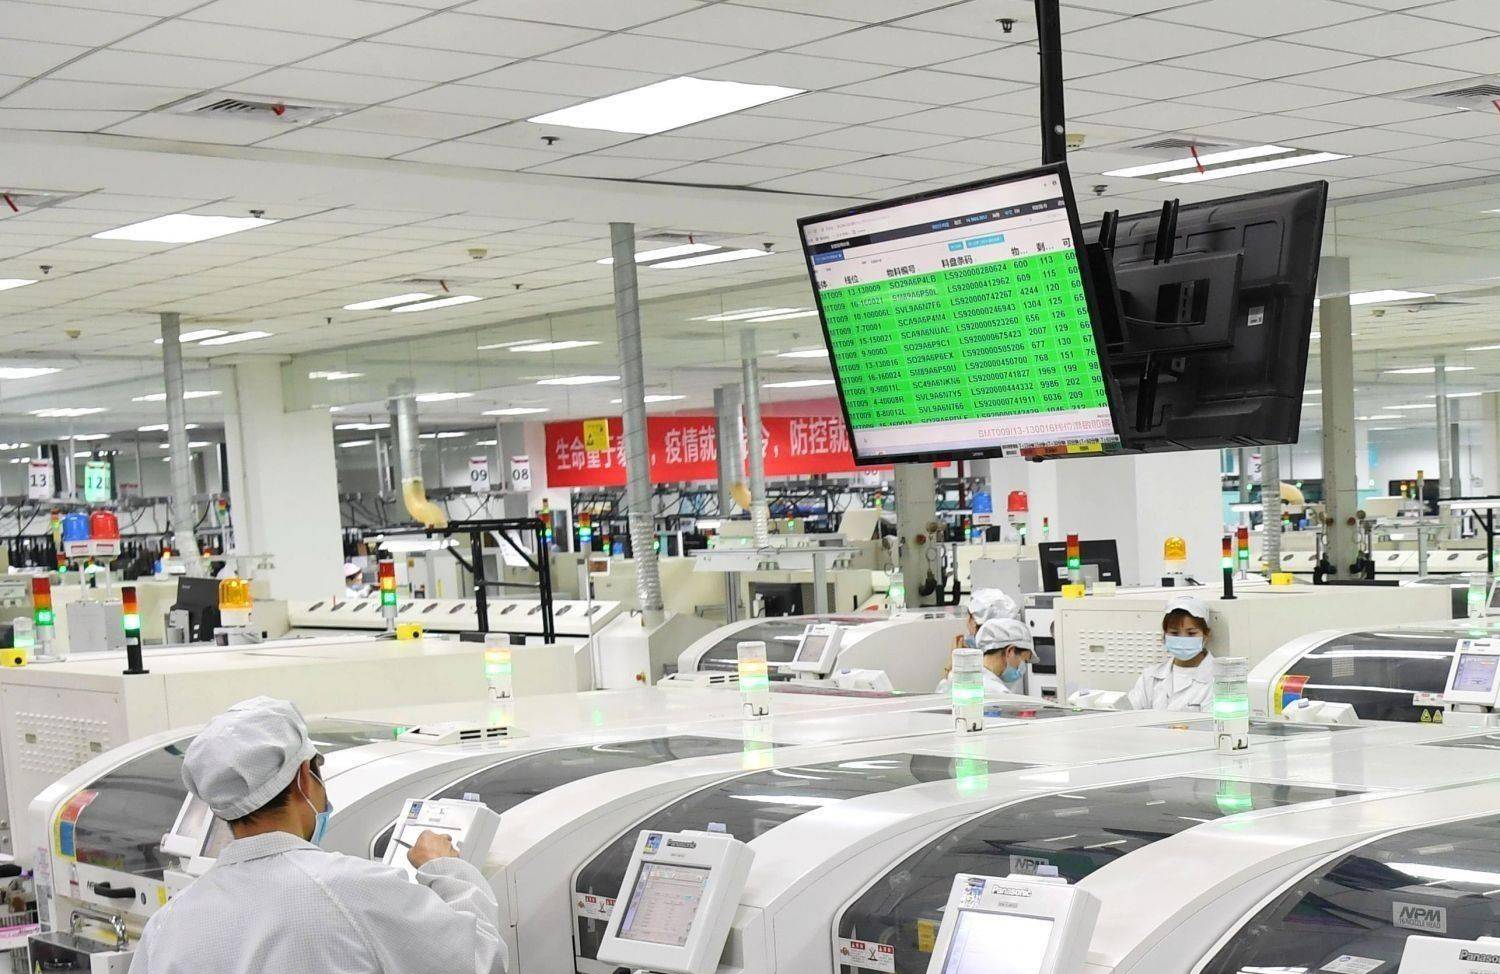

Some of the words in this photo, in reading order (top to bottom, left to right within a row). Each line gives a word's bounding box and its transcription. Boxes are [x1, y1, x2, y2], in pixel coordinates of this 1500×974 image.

[1039, 255, 1053, 264] 113
[1064, 251, 1076, 260] 60
[1042, 269, 1056, 278] 115
[1067, 265, 1079, 274] 60
[1045, 283, 1059, 292] 120
[1070, 279, 1082, 288] 60
[1048, 296, 1062, 305] 125
[1073, 293, 1085, 302] 65
[1051, 310, 1065, 319] 126
[1076, 307, 1088, 315] 65
[1054, 323, 1068, 332] 129
[1079, 320, 1091, 329] 66
[1057, 337, 1071, 346] 130
[1082, 334, 1094, 343] 67
[1060, 350, 1074, 359] 151
[1085, 348, 1097, 356] 76
[1063, 364, 1077, 372] 199
[1088, 361, 1100, 370] 98
[1066, 377, 1080, 386] 202
[1091, 375, 1103, 383] 90
[1069, 391, 1083, 399] 209
[1095, 388, 1106, 396] 10
[471, 470, 488, 482] 09
[513, 468, 529, 480] 08
[30, 474, 47, 488] 13
[88, 476, 103, 489] 12
[666, 838, 697, 850] Panasonic
[991, 884, 1033, 898] Panasonic
[1400, 906, 1441, 923] NPM
